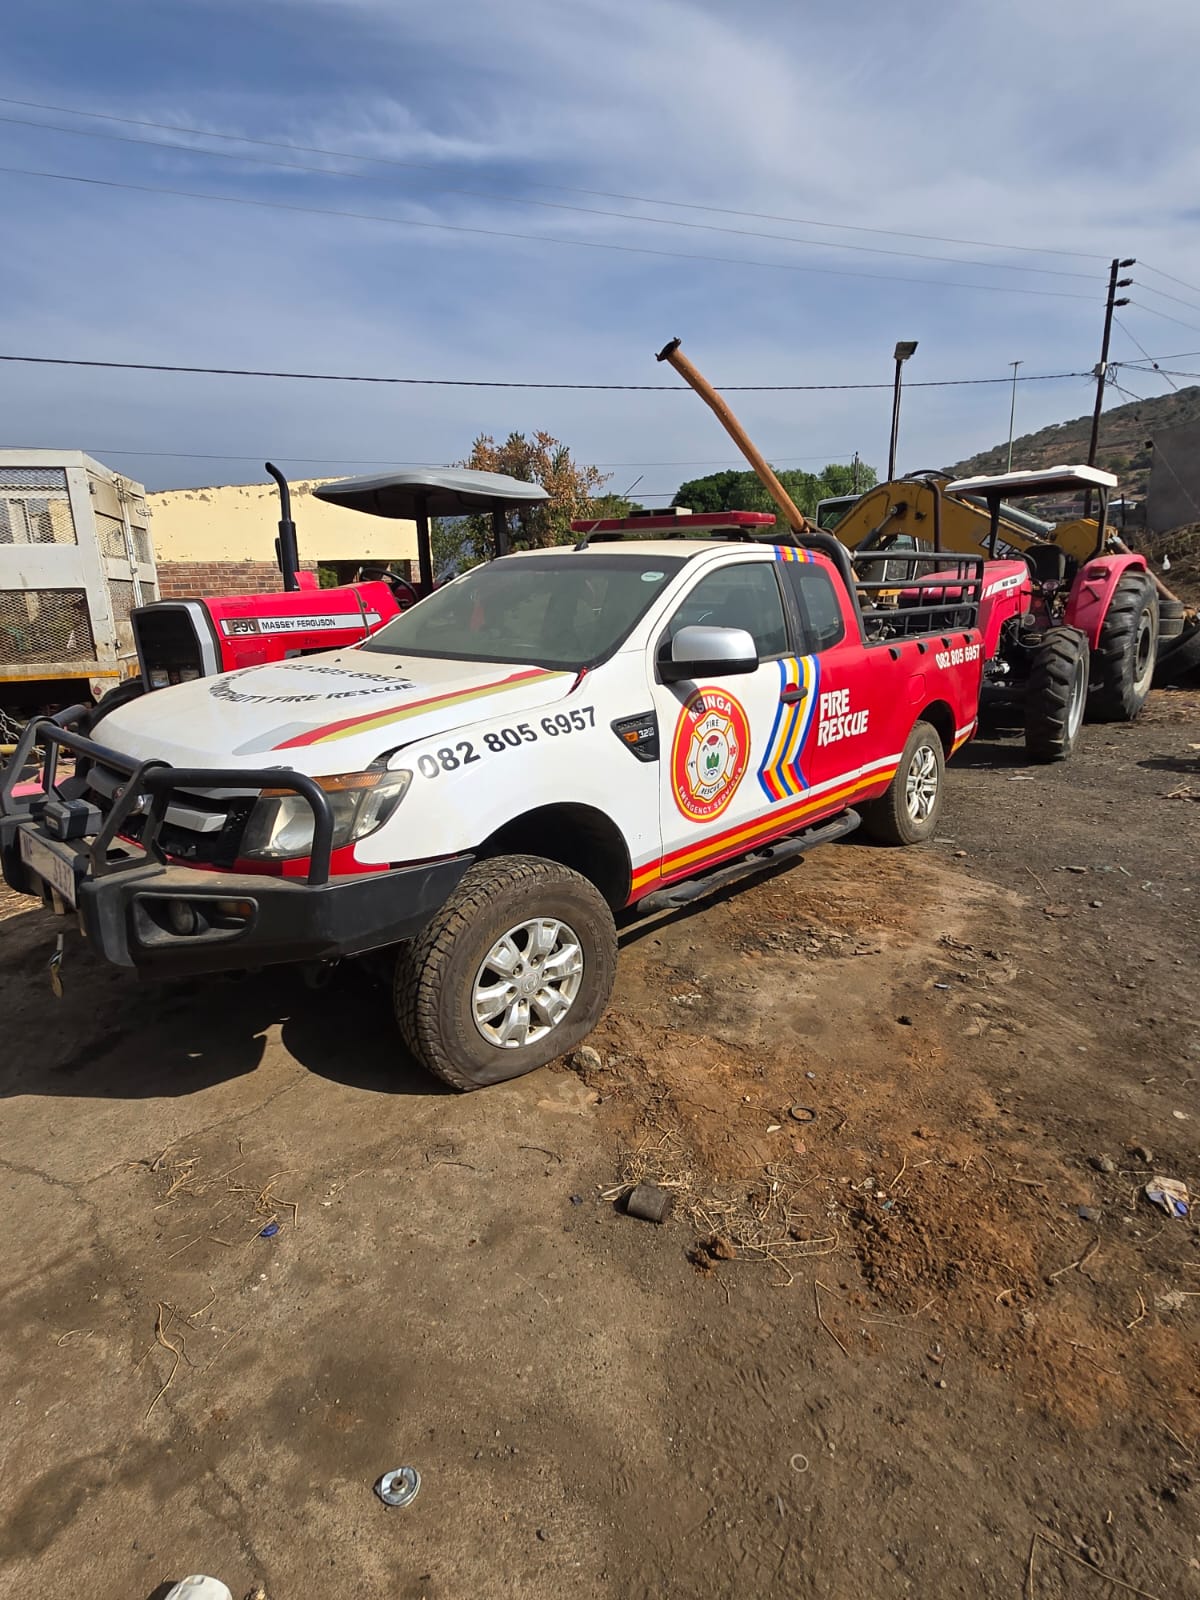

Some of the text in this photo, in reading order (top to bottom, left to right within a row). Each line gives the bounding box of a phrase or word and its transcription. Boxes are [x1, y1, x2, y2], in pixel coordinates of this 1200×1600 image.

[232, 618, 336, 633] 290 MASSEY FERGUSON
[935, 644, 980, 670] 082 805 6957
[309, 667, 353, 675] 805
[348, 672, 412, 684] 6957
[266, 694, 323, 704] FIRE
[326, 682, 417, 700] RESCUE
[819, 687, 850, 722] FIRE
[687, 695, 732, 723] MSINGA
[705, 719, 720, 729] FIRE
[817, 709, 869, 747] RESCUE
[417, 706, 595, 779] 082 805 6957
[678, 785, 712, 814] EMERGENCY
